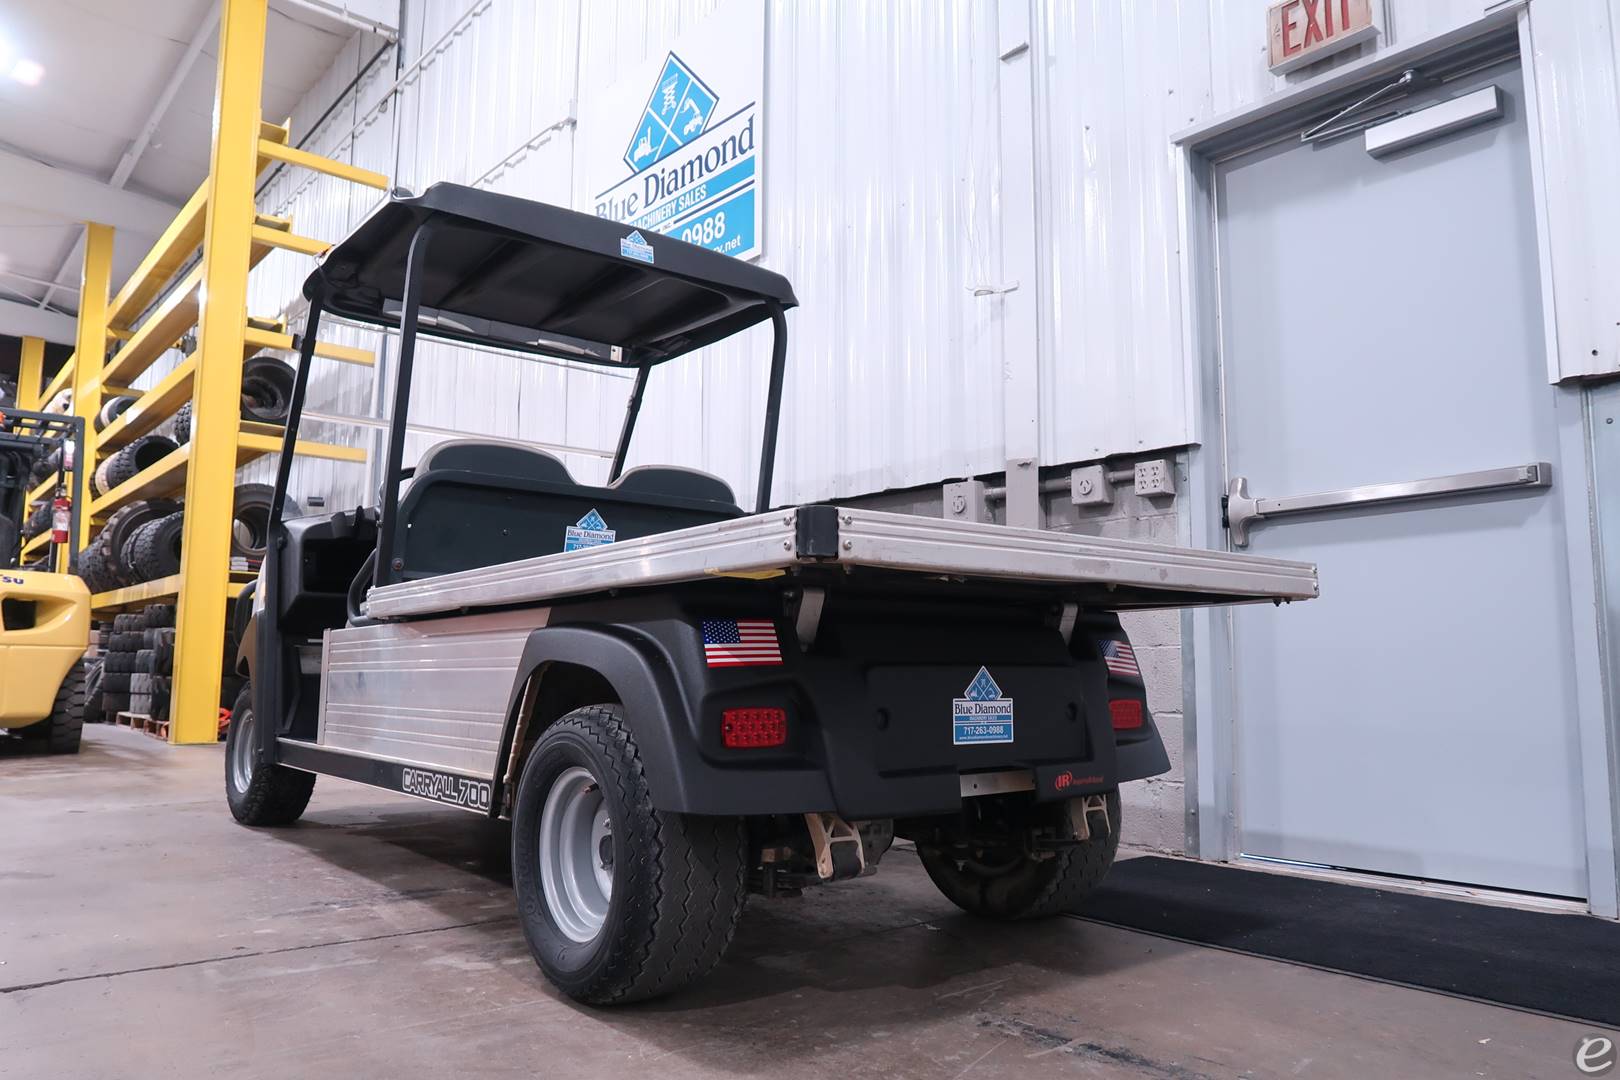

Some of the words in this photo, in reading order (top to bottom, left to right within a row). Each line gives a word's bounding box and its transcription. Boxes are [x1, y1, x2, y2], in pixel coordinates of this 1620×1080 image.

[595, 193, 638, 221] Blue
[643, 113, 756, 209] Diamond
[678, 184, 707, 212] SALES
[682, 211, 726, 246] 0988
[584, 531, 614, 540] Diamond
[955, 703, 973, 714] Blue
[975, 703, 1011, 714] Diamond
[963, 725, 1004, 735] 717-263-0988
[403, 768, 458, 803] CARRYALL
[458, 779, 490, 810] 700
